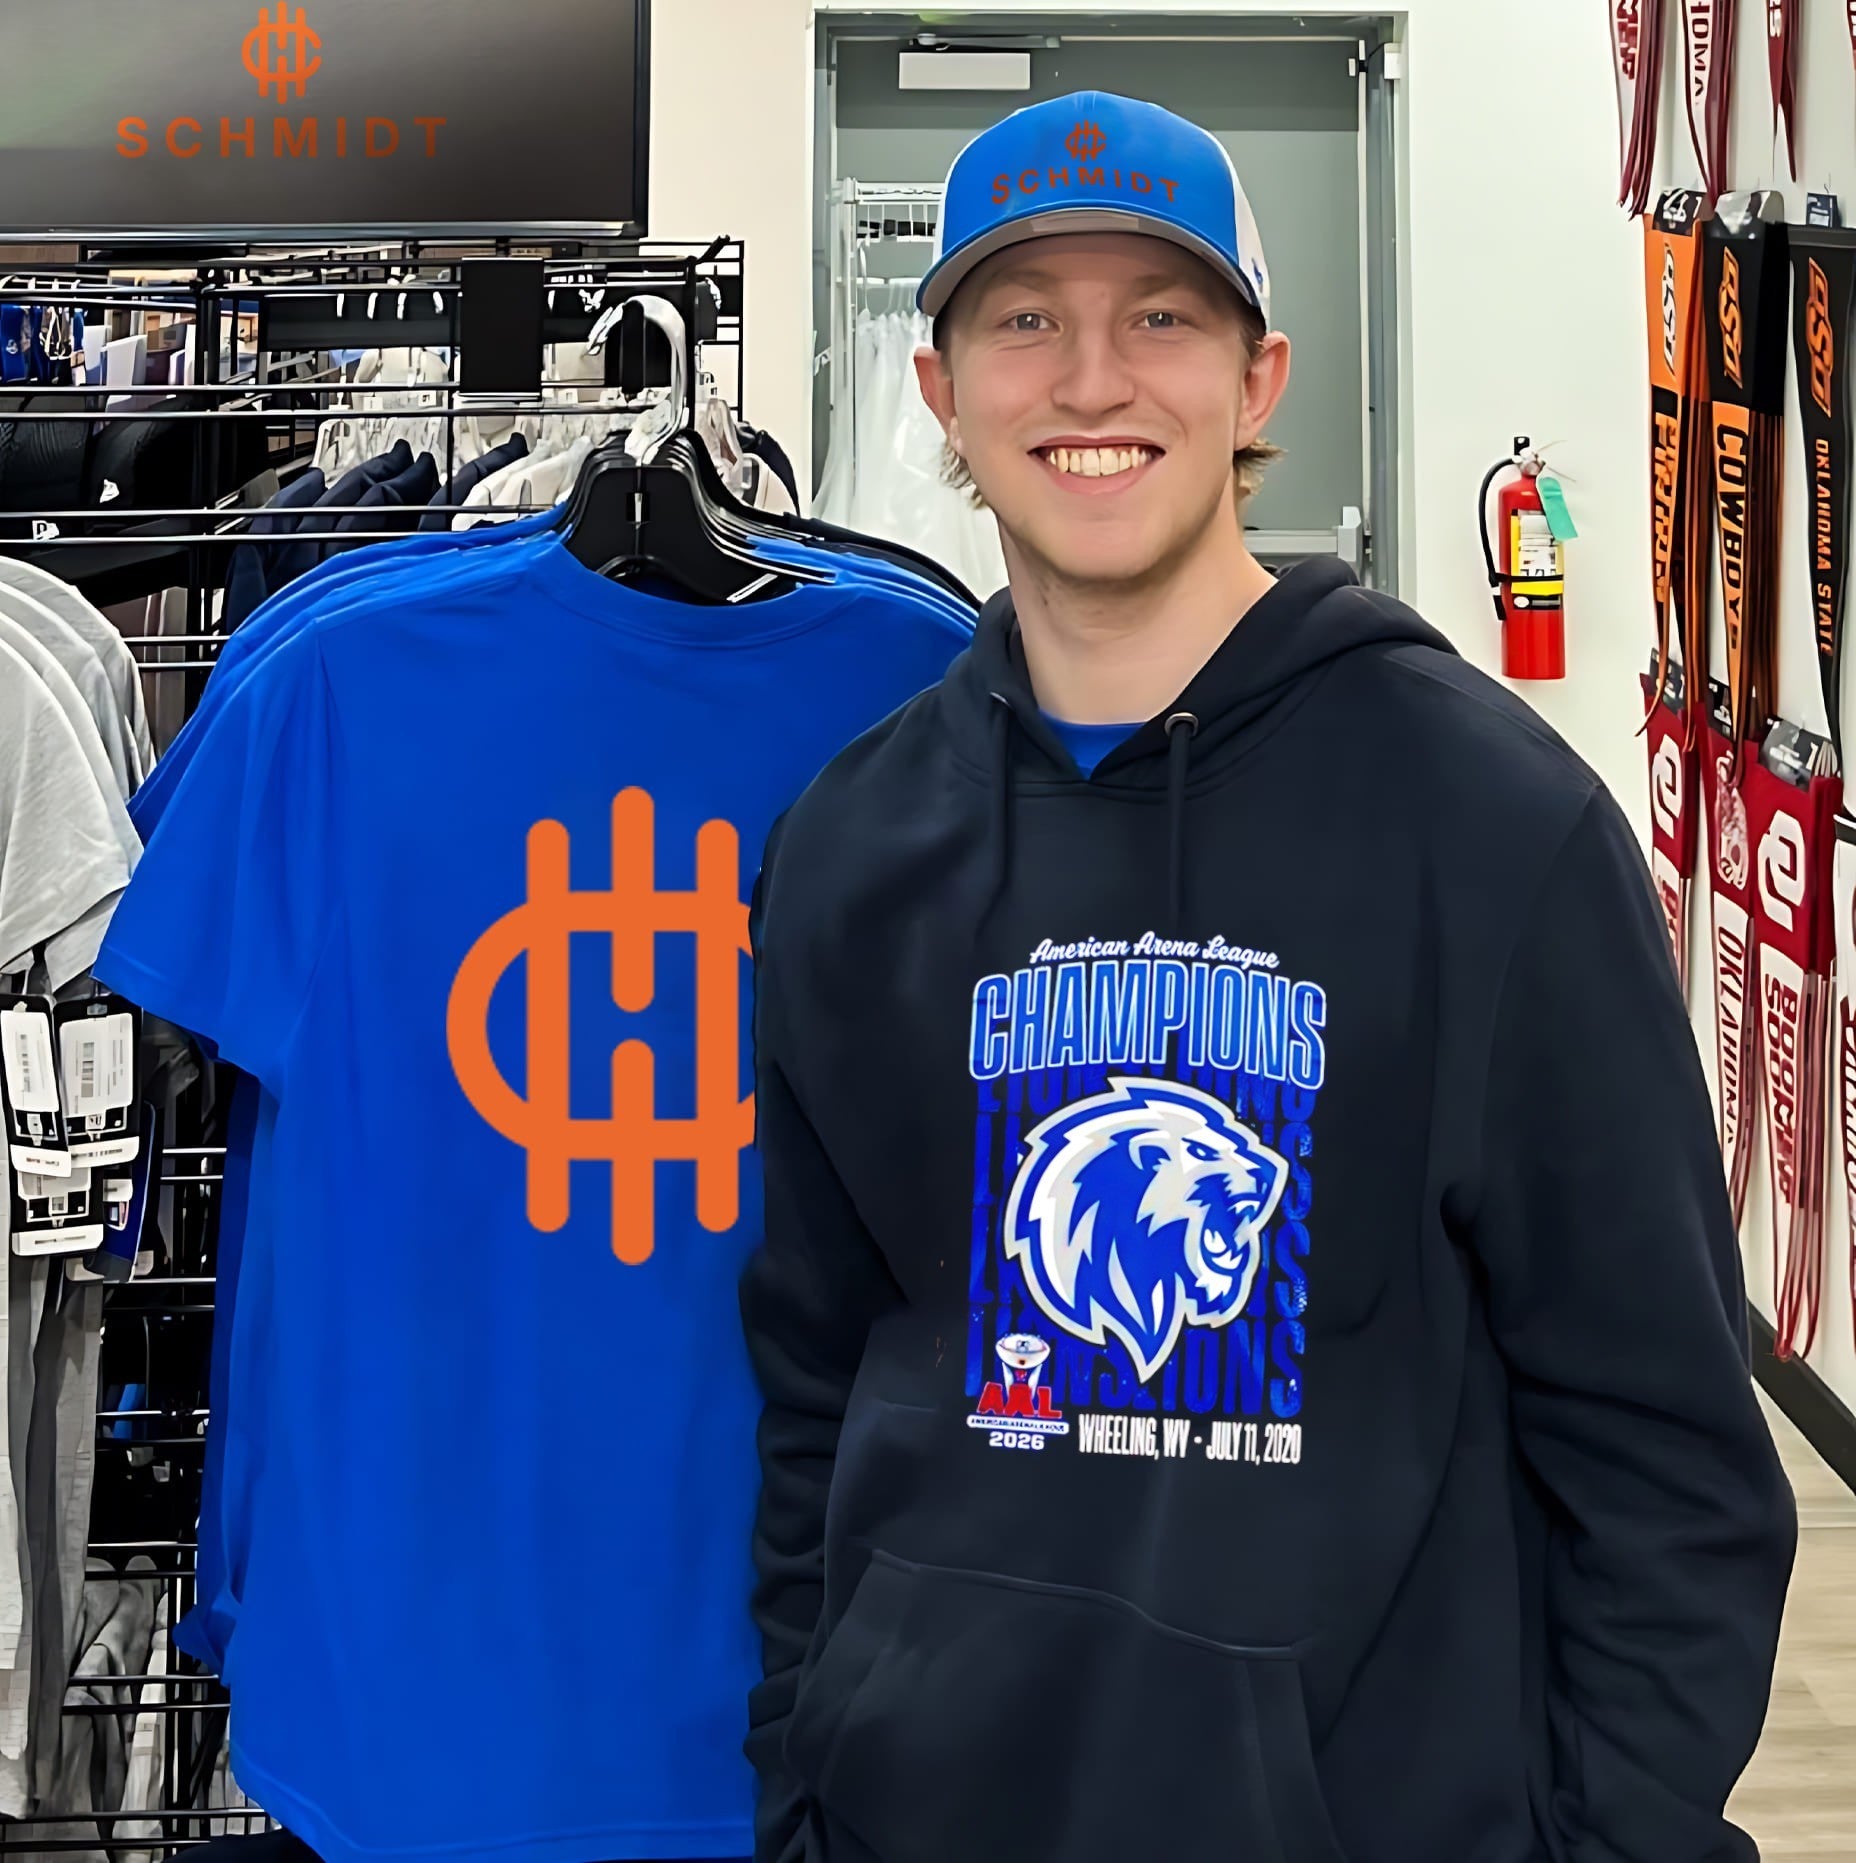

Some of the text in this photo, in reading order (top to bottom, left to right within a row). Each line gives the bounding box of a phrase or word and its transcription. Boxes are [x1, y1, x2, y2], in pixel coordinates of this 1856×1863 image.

[115, 116, 448, 158] SCHMIDT
[991, 167, 1180, 205] SCHMIDT
[1815, 438, 1832, 571] OKLAHOMA
[1029, 930, 1281, 970] American Arena League
[968, 958, 1327, 1090] CHAMPIONS
[976, 1381, 1063, 1420] AAL
[988, 1430, 1046, 1451] 2026
[1078, 1413, 1159, 1461] WHEELING,
[1206, 1420, 1243, 1461] JULY
